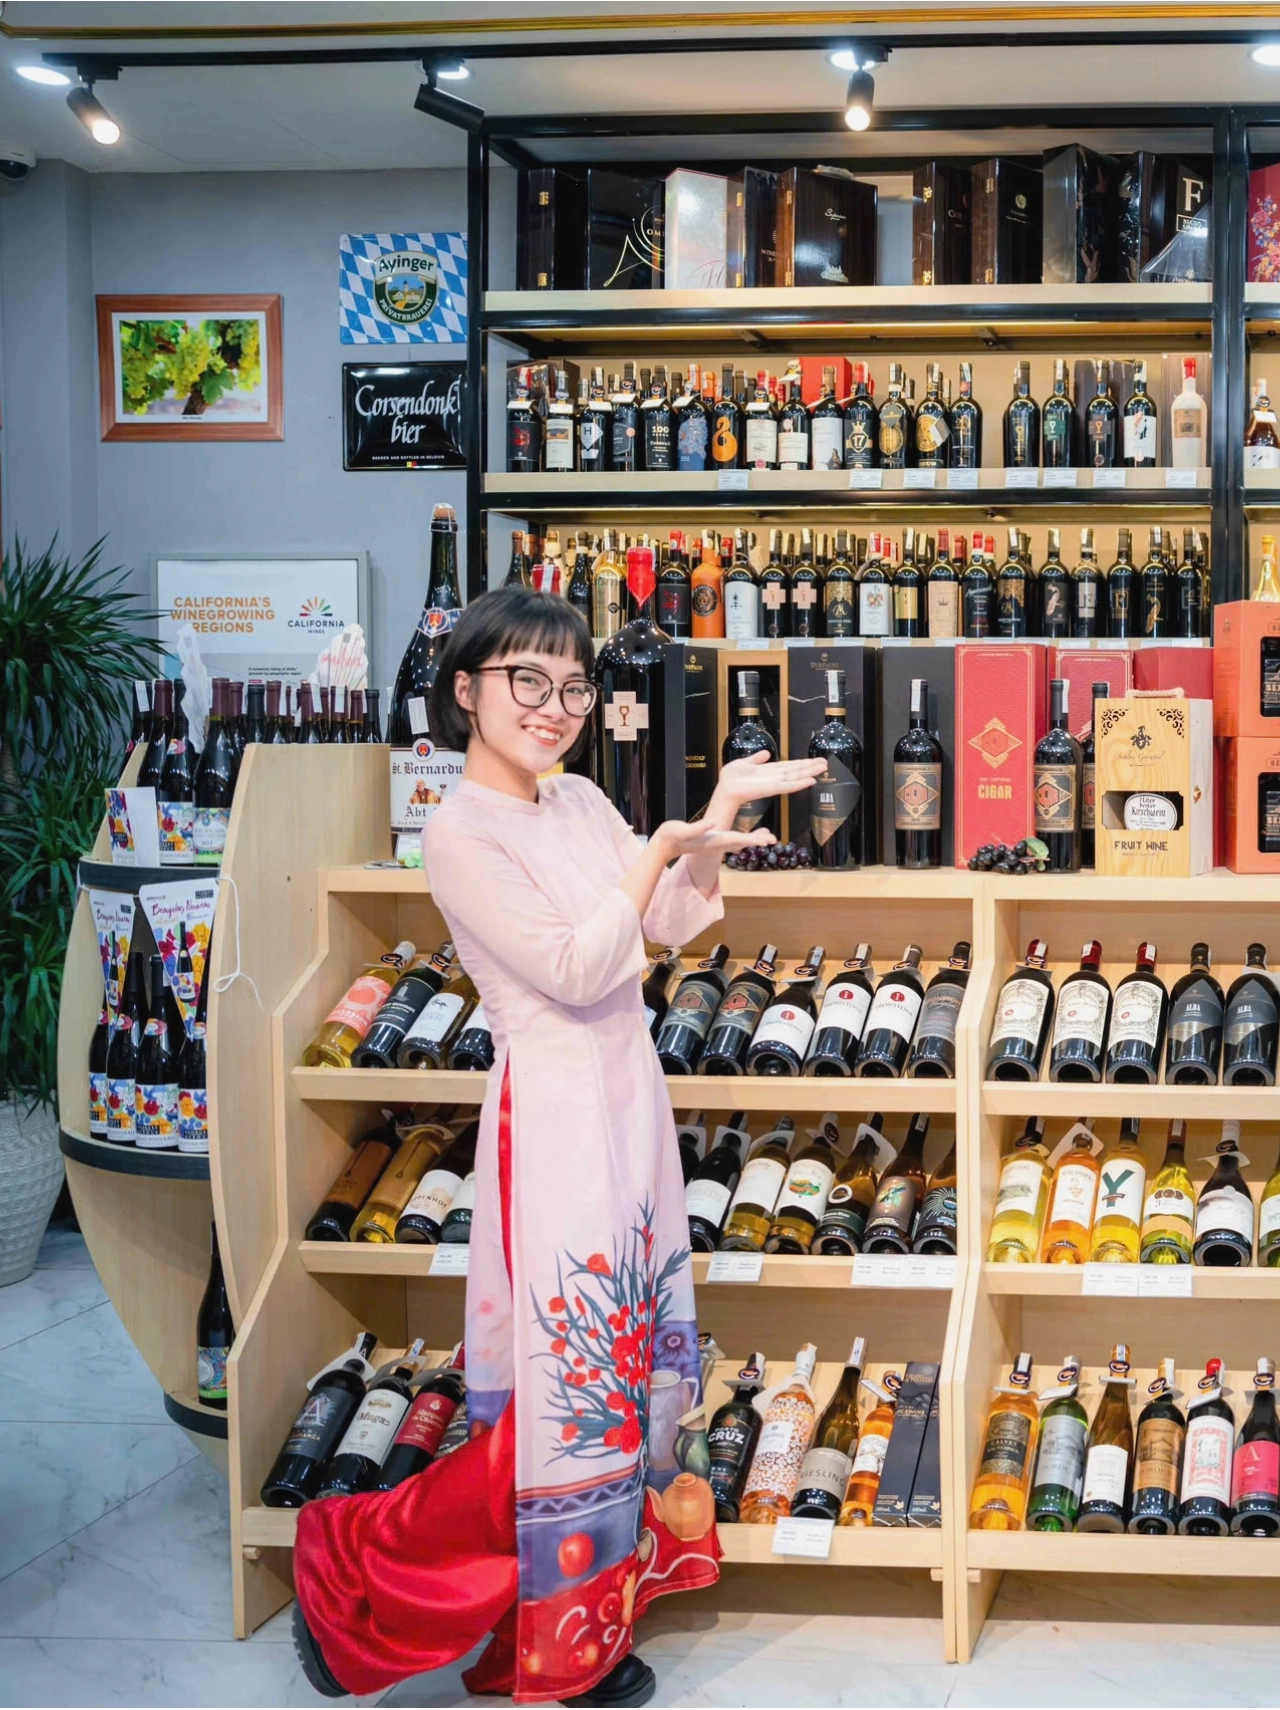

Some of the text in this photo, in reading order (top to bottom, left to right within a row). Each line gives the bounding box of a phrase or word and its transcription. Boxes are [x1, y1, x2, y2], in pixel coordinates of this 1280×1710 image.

[378, 254, 435, 273] Ayinger
[379, 298, 433, 322] PRIVATBRAUEREI
[355, 379, 460, 419] Corsendonk
[390, 414, 426, 444] bier
[651, 425, 669, 434] 100
[853, 435, 863, 447] 17
[174, 596, 271, 608] CALIFORNIA'S
[171, 609, 275, 621] WINEGROWING
[192, 621, 254, 633] REGIONS
[288, 620, 345, 628] CALIFORNIA
[403, 762, 463, 775] Bernardu
[977, 785, 1012, 799] CIGAR
[404, 806, 427, 819] Abt
[1114, 841, 1168, 850] FRUIT WINE
[1185, 1003, 1201, 1012] ALBA
[1236, 1004, 1252, 1014] ALBA
[356, 1411, 391, 1427] Muga
[708, 1429, 745, 1444] CRUZ
[802, 1468, 845, 1487] RIESLING
